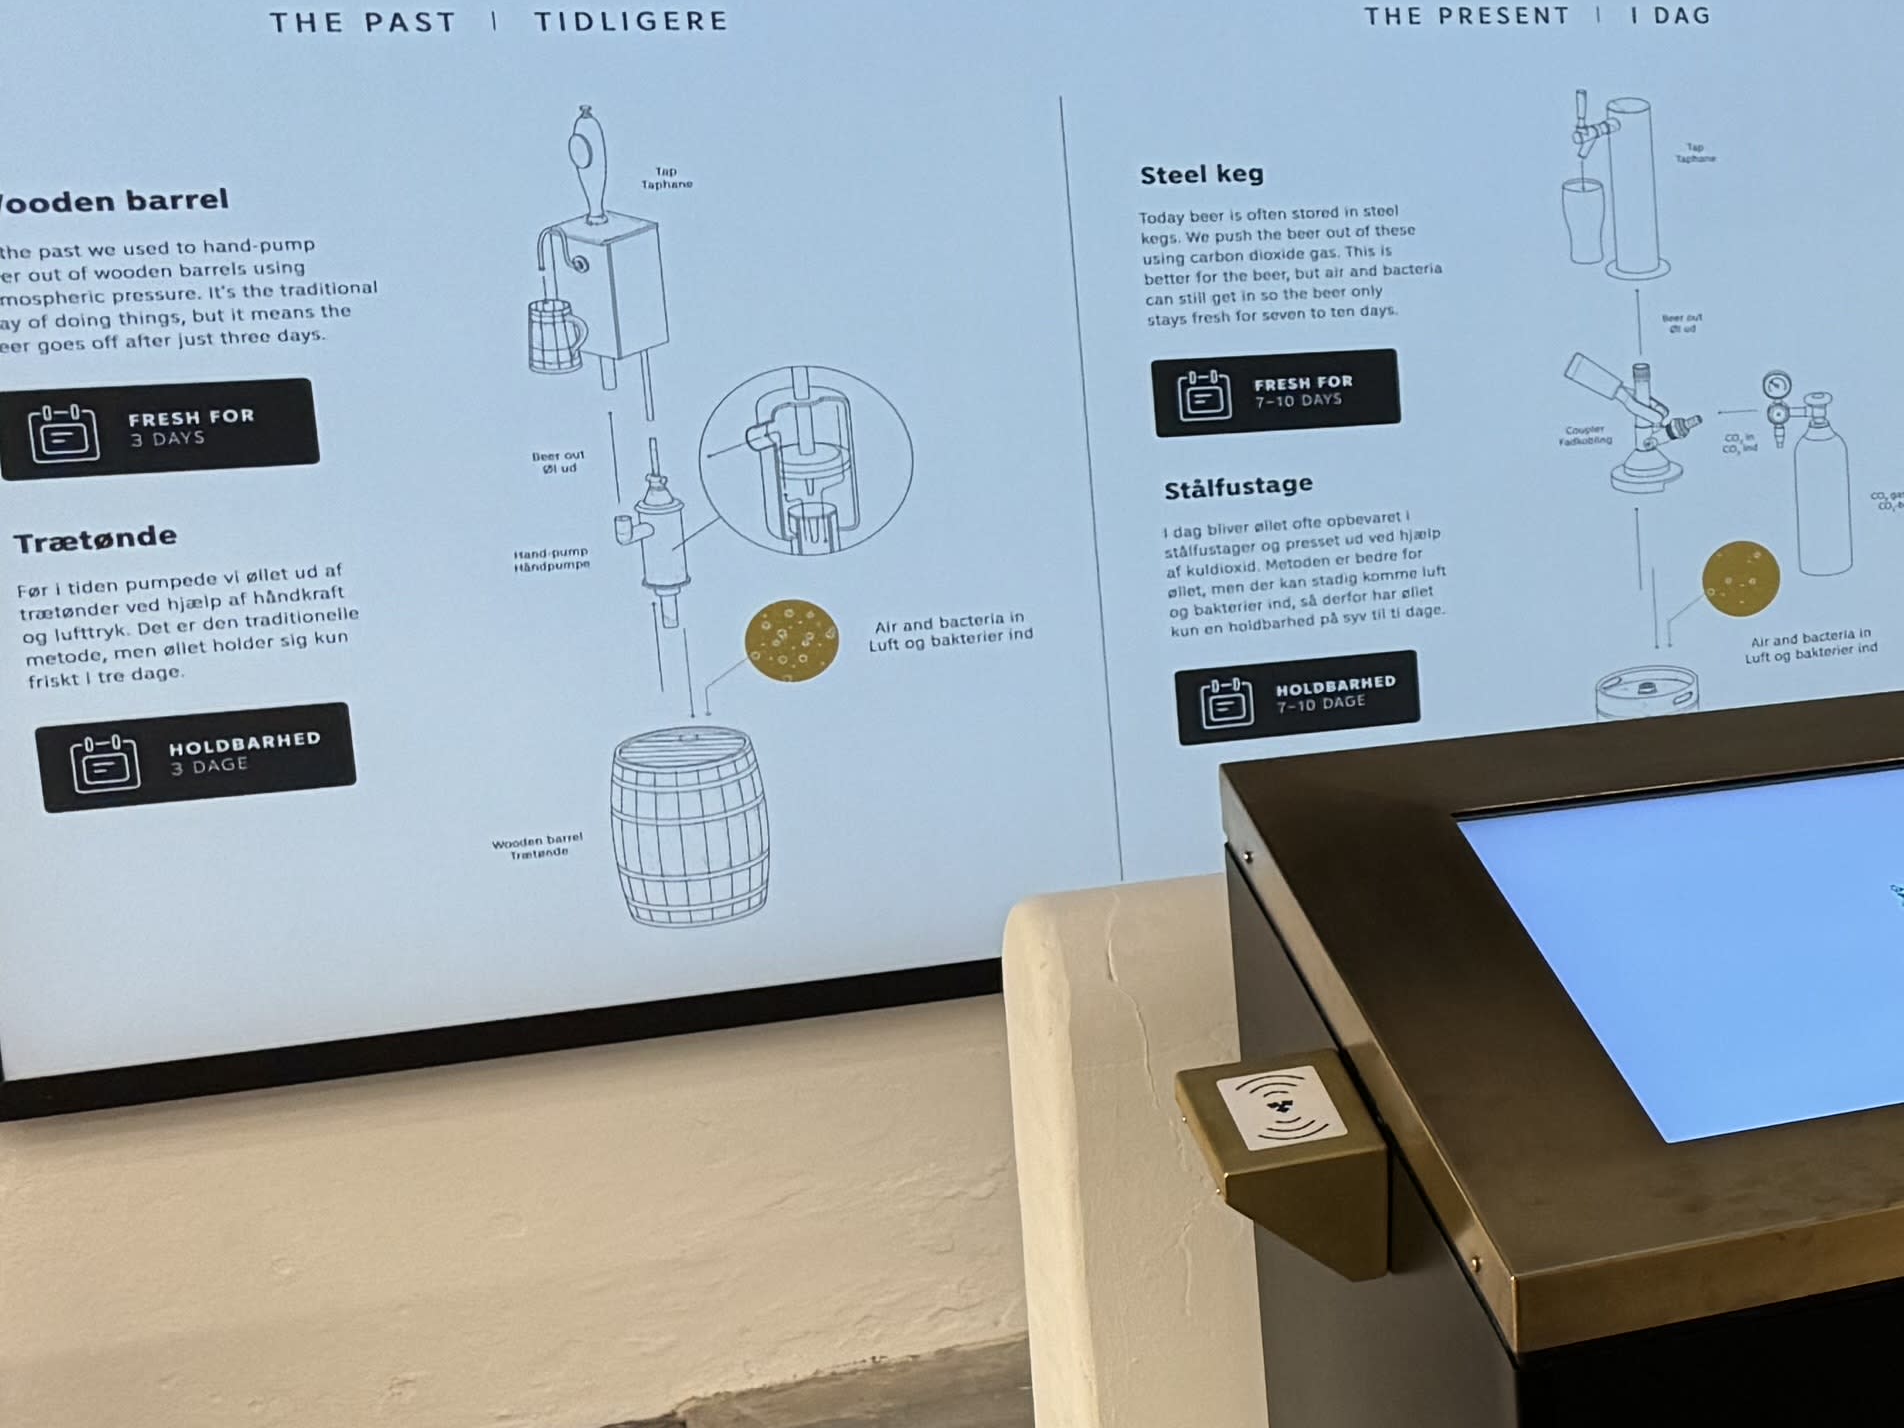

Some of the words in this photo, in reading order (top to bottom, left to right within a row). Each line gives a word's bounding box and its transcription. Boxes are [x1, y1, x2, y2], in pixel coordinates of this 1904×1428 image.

[269, 12, 342, 34] THE
[365, 11, 455, 33] PAST
[533, 10, 727, 32] TIDLIGERE
[1364, 6, 1422, 26] THE
[1438, 6, 1569, 26] PRESENT
[1654, 6, 1710, 25] DAG
[1140, 163, 1207, 186] Steel
[1216, 163, 1264, 187] keg
[0, 190, 116, 215] ooden
[125, 187, 229, 212] barrel
[1138, 211, 1186, 227] Today
[1189, 209, 1224, 224] beer
[1229, 210, 1243, 222] is
[1246, 207, 1288, 222] often
[1291, 205, 1340, 220] stored
[1344, 207, 1359, 218] in
[1363, 204, 1399, 218] steel
[0, 245, 32, 260] the
[39, 244, 81, 262] past
[87, 246, 116, 258] we
[123, 240, 170, 256] used
[176, 242, 197, 255] to
[203, 237, 316, 256] hand-pump
[28, 268, 62, 283] out
[67, 265, 88, 282] of
[93, 264, 173, 280] wooden
[178, 261, 247, 278] barrels
[253, 260, 306, 277] using
[1254, 376, 1311, 392] FRESH
[1317, 374, 1353, 389] FOR
[1301, 392, 1342, 407] DAYS
[128, 410, 200, 428] FRESH
[209, 408, 254, 424] FOR
[130, 432, 143, 448] 3
[152, 429, 205, 447] DAYS
[1164, 477, 1314, 501] Stålfustage
[12, 524, 178, 554] Trætønde
[1275, 674, 1398, 698] HOLDBARHED
[1322, 693, 1366, 710] DAGE
[168, 730, 322, 758] HOLDBARHED
[171, 761, 184, 776] 3
[192, 755, 248, 774] DAGE
